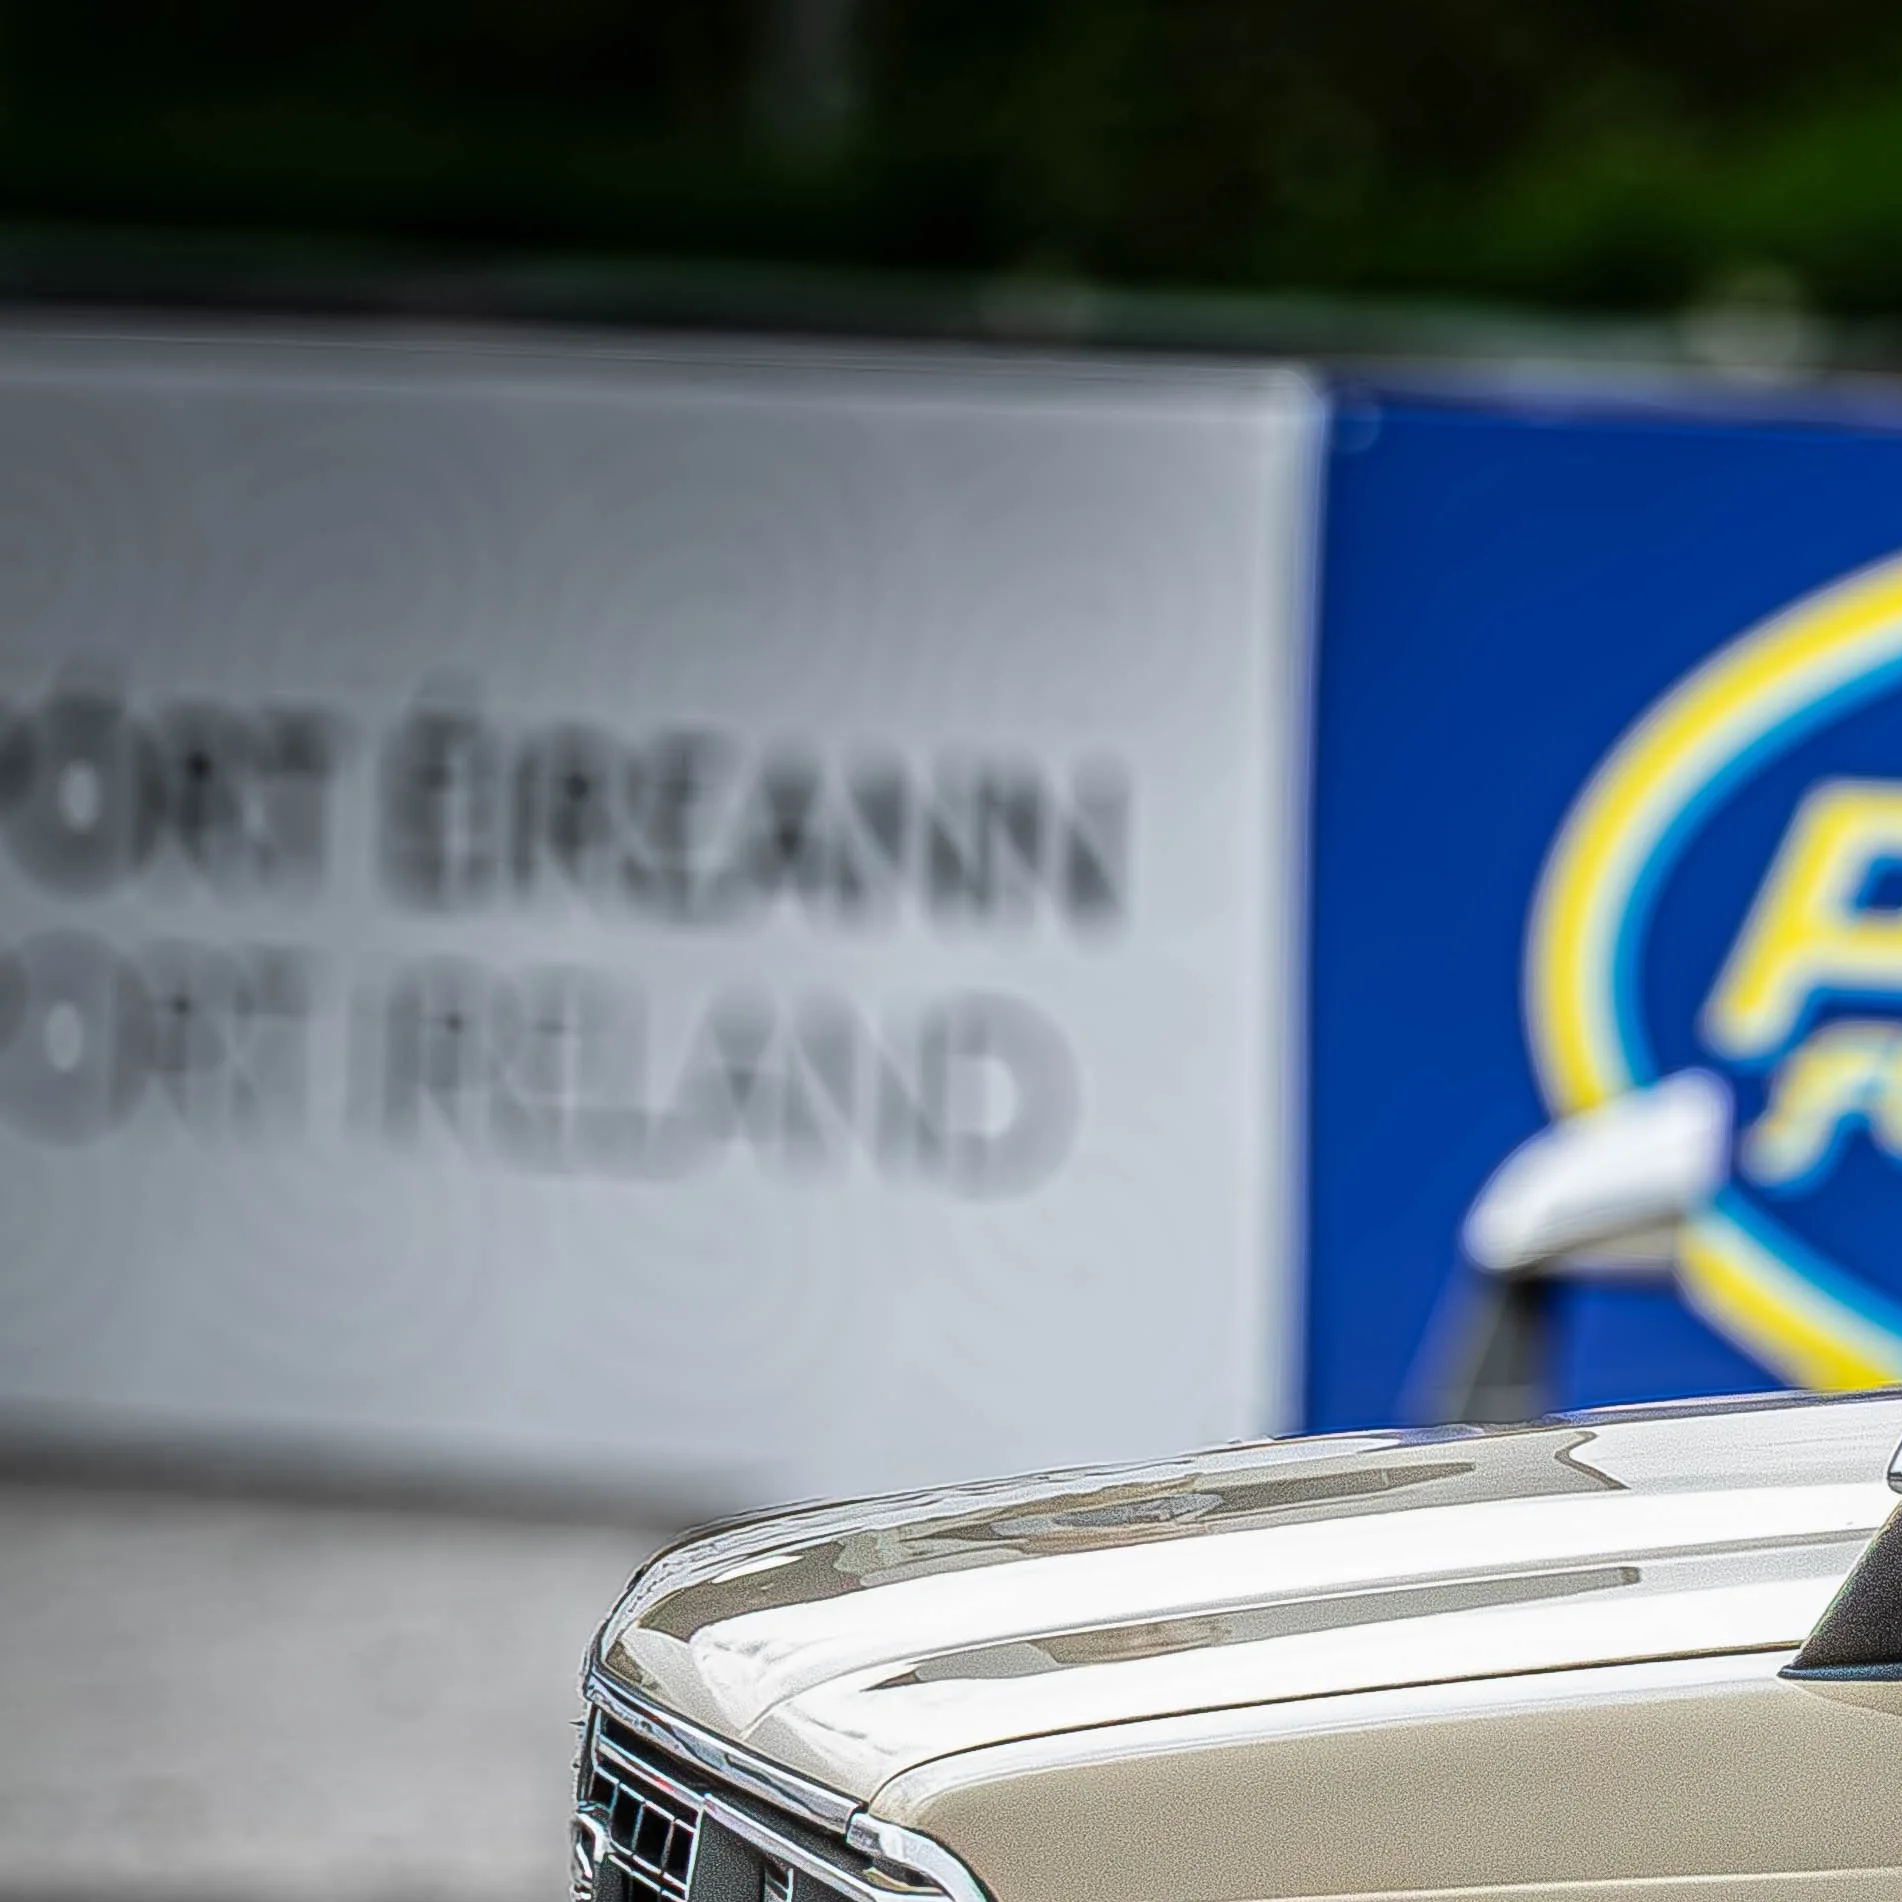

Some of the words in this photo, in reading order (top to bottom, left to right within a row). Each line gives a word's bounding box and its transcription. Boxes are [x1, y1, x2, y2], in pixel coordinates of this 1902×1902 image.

[0, 655, 345, 905] ÓRT
[0, 928, 325, 1148] ORT
[347, 955, 1085, 1205] IRELAND
